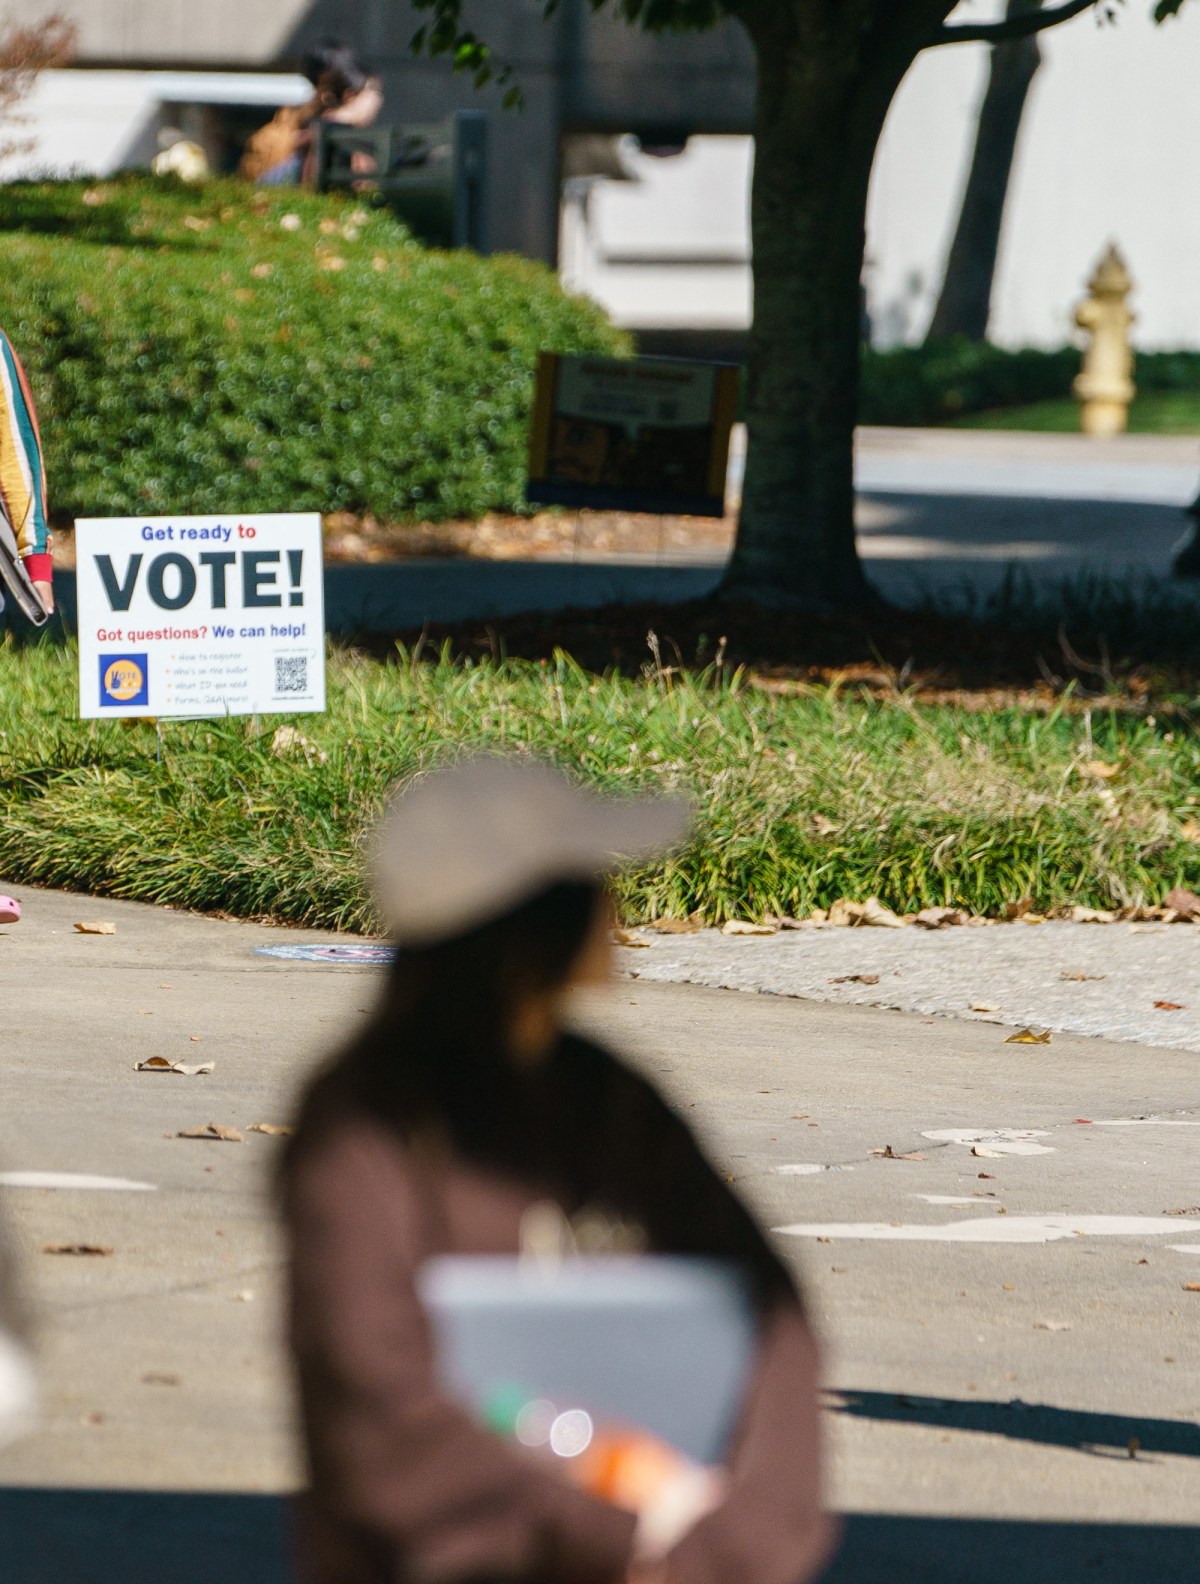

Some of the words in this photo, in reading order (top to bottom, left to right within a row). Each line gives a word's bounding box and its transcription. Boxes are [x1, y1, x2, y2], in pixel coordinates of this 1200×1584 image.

[140, 526, 174, 541] Get
[180, 524, 232, 543] ready
[237, 524, 256, 539] to
[93, 549, 304, 612] VOTE!
[96, 627, 123, 642] Got
[127, 626, 208, 644] questions?
[212, 625, 235, 639] We
[239, 626, 265, 638] can
[270, 623, 306, 640] help!
[179, 653, 196, 661] How
[199, 653, 207, 661] to
[210, 653, 241, 663] register
[226, 666, 248, 674] ballot
[175, 682, 196, 690] What
[199, 680, 212, 690] ID
[229, 680, 247, 688] need
